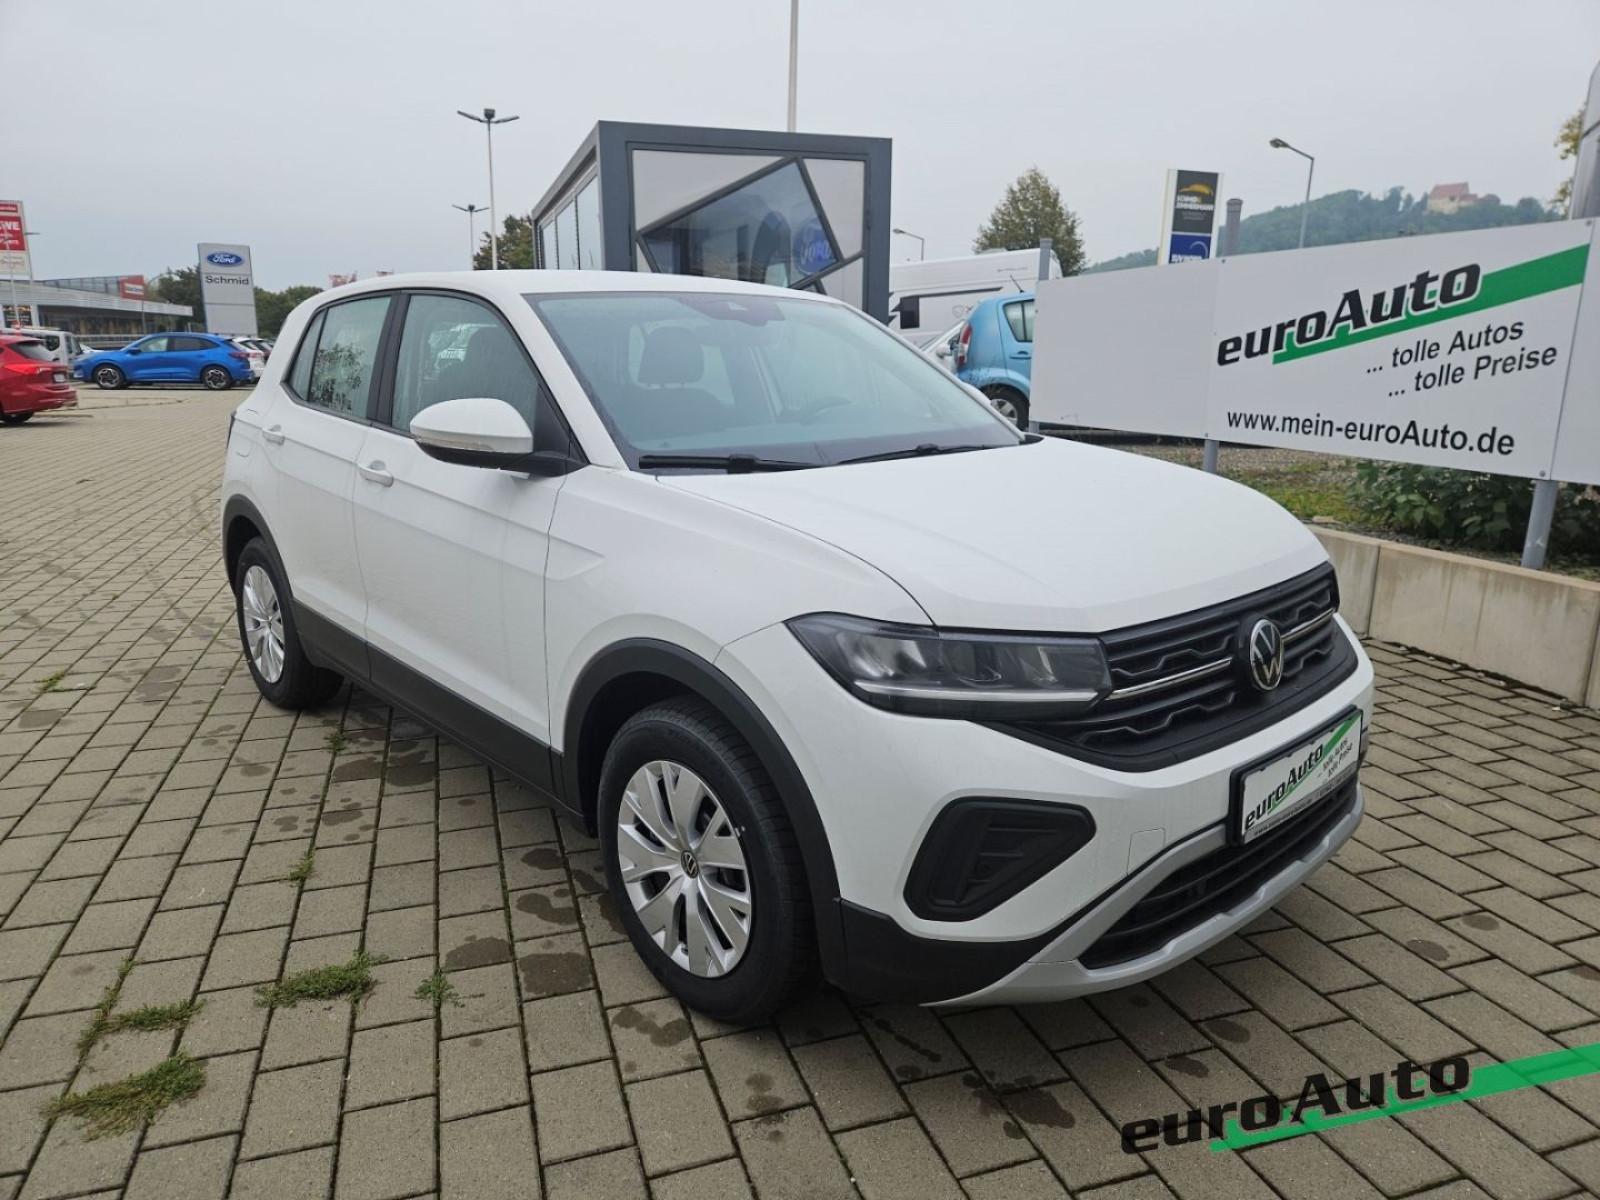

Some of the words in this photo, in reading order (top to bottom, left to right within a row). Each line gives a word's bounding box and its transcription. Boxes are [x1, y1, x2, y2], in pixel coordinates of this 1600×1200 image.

[205, 274, 250, 285] Schmid
[1216, 263, 1482, 367] euroAuto
[1391, 339, 1441, 368] tolle
[1447, 321, 1525, 355] Autos
[1414, 363, 1466, 393] tolle
[1474, 345, 1558, 380] Preise
[1227, 411, 1516, 457] www.mein-euroAuto.de
[1245, 744, 1323, 830] euroAuto
